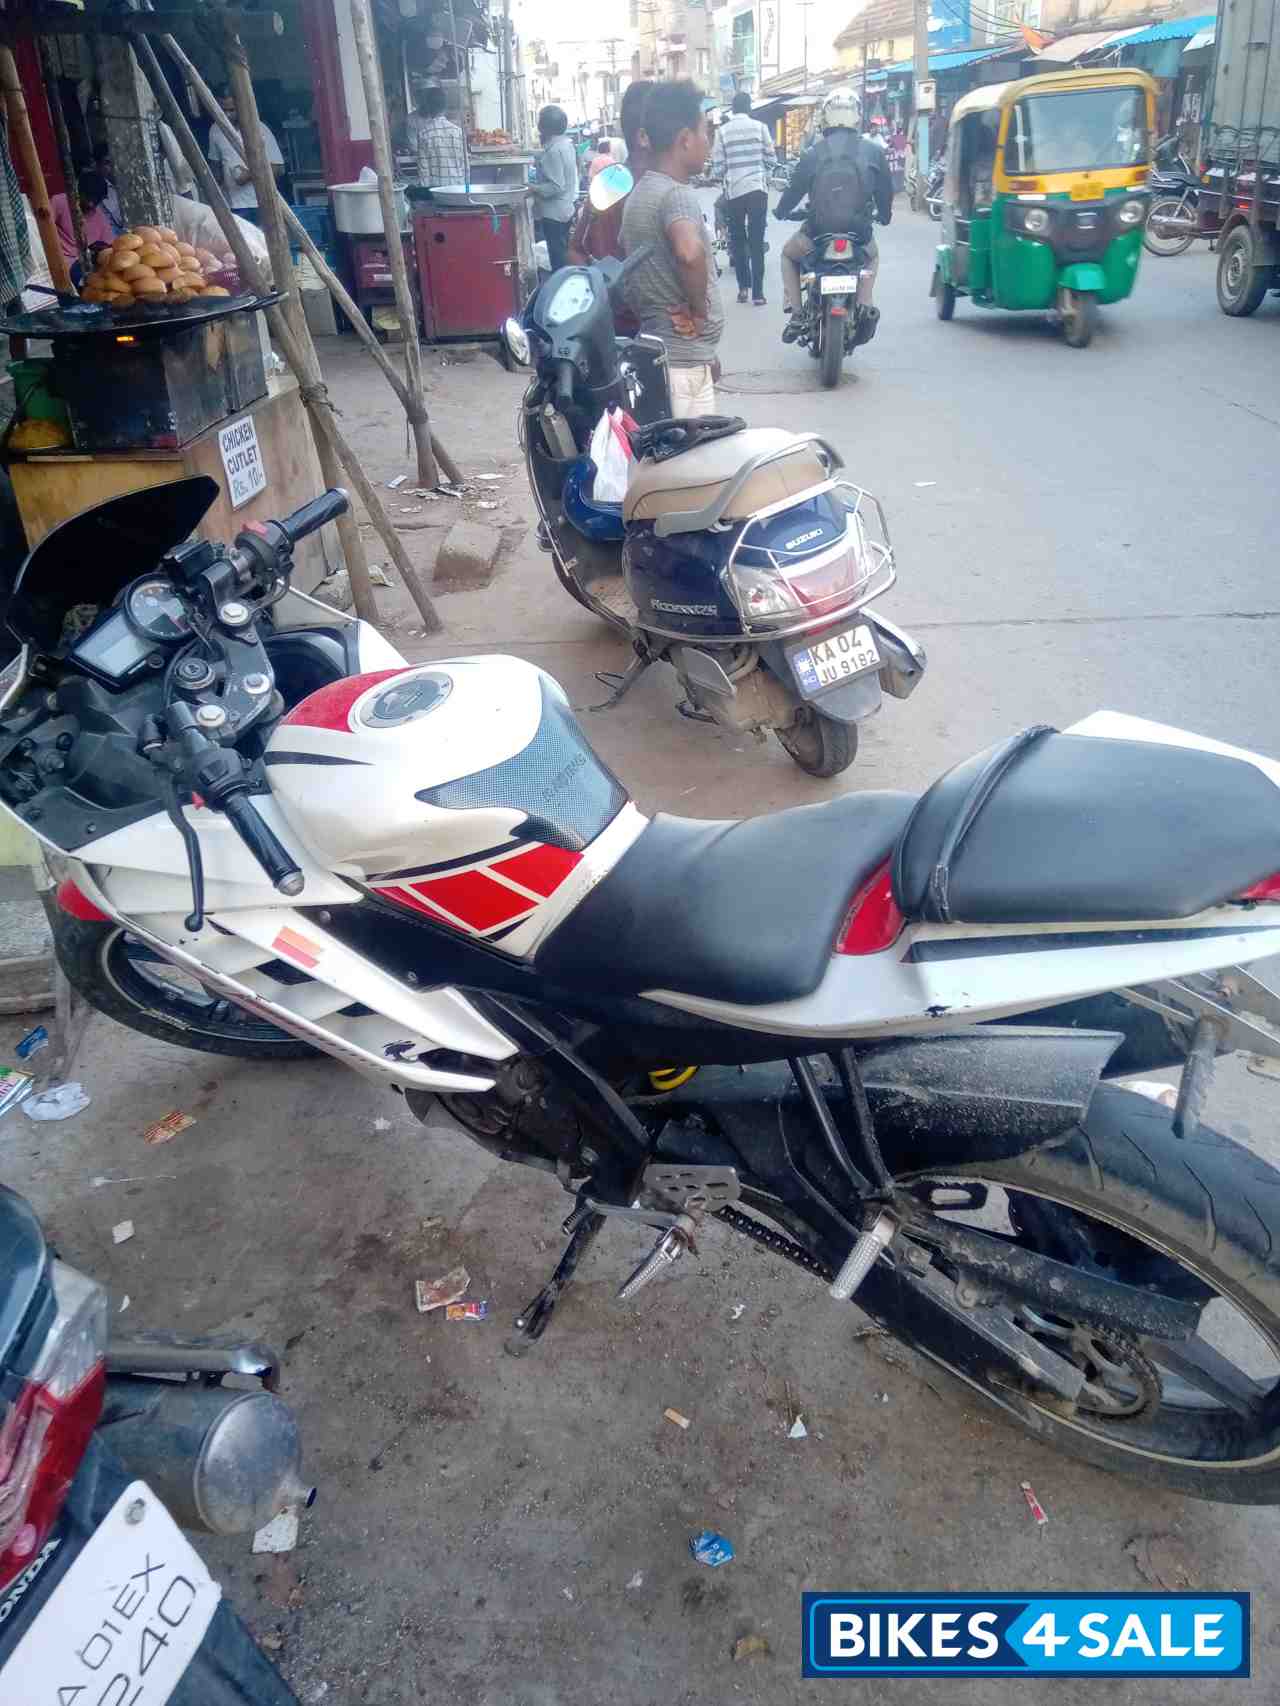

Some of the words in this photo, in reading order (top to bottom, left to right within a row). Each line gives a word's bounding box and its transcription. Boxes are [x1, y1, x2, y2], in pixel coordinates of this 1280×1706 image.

[222, 422, 254, 453] CHICKEN
[227, 445, 257, 475] CUTLET
[810, 642, 837, 667] KA
[837, 629, 862, 654] 04
[820, 665, 838, 684] JU
[841, 649, 877, 675] 9182
